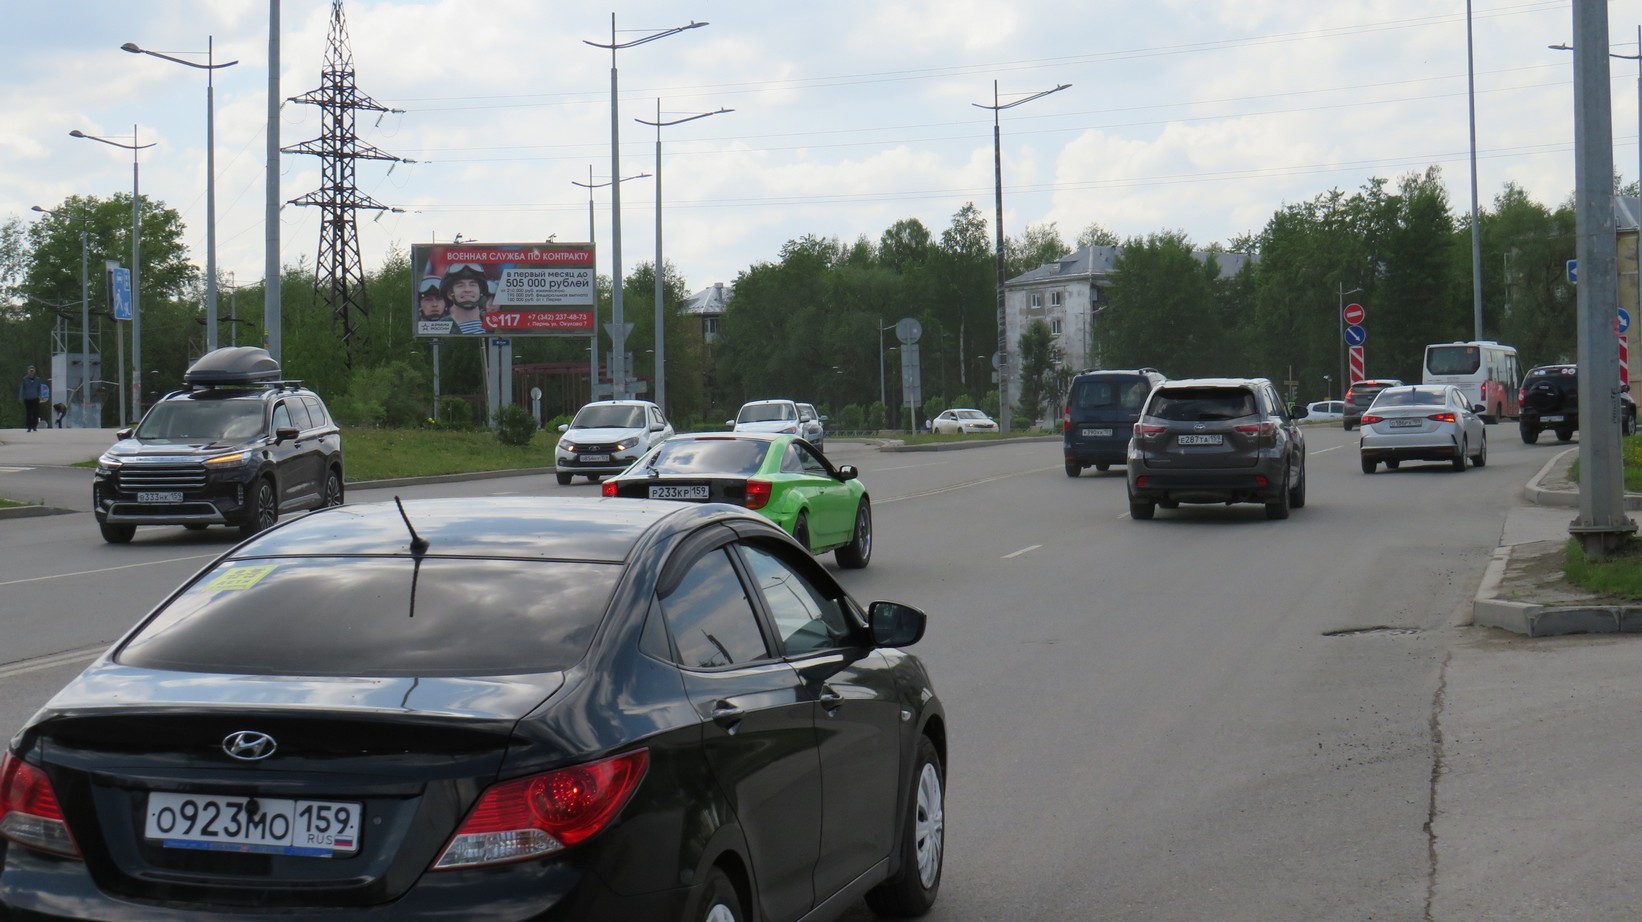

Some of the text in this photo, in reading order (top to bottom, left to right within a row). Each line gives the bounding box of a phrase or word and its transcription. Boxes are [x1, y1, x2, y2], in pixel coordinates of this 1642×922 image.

[447, 252, 589, 260] ВОЕННАЯ СЛУЖБА ПО КОНТРАКТУ
[513, 271, 546, 279] первый
[506, 277, 589, 289] 505 000 рублей
[498, 314, 520, 326] 117
[537, 313, 554, 321] (342)
[1180, 435, 1208, 444] Е287ТА
[652, 486, 706, 498] Р233КР 159
[156, 799, 351, 841] О923МО 159
[307, 833, 333, 845] RUS
